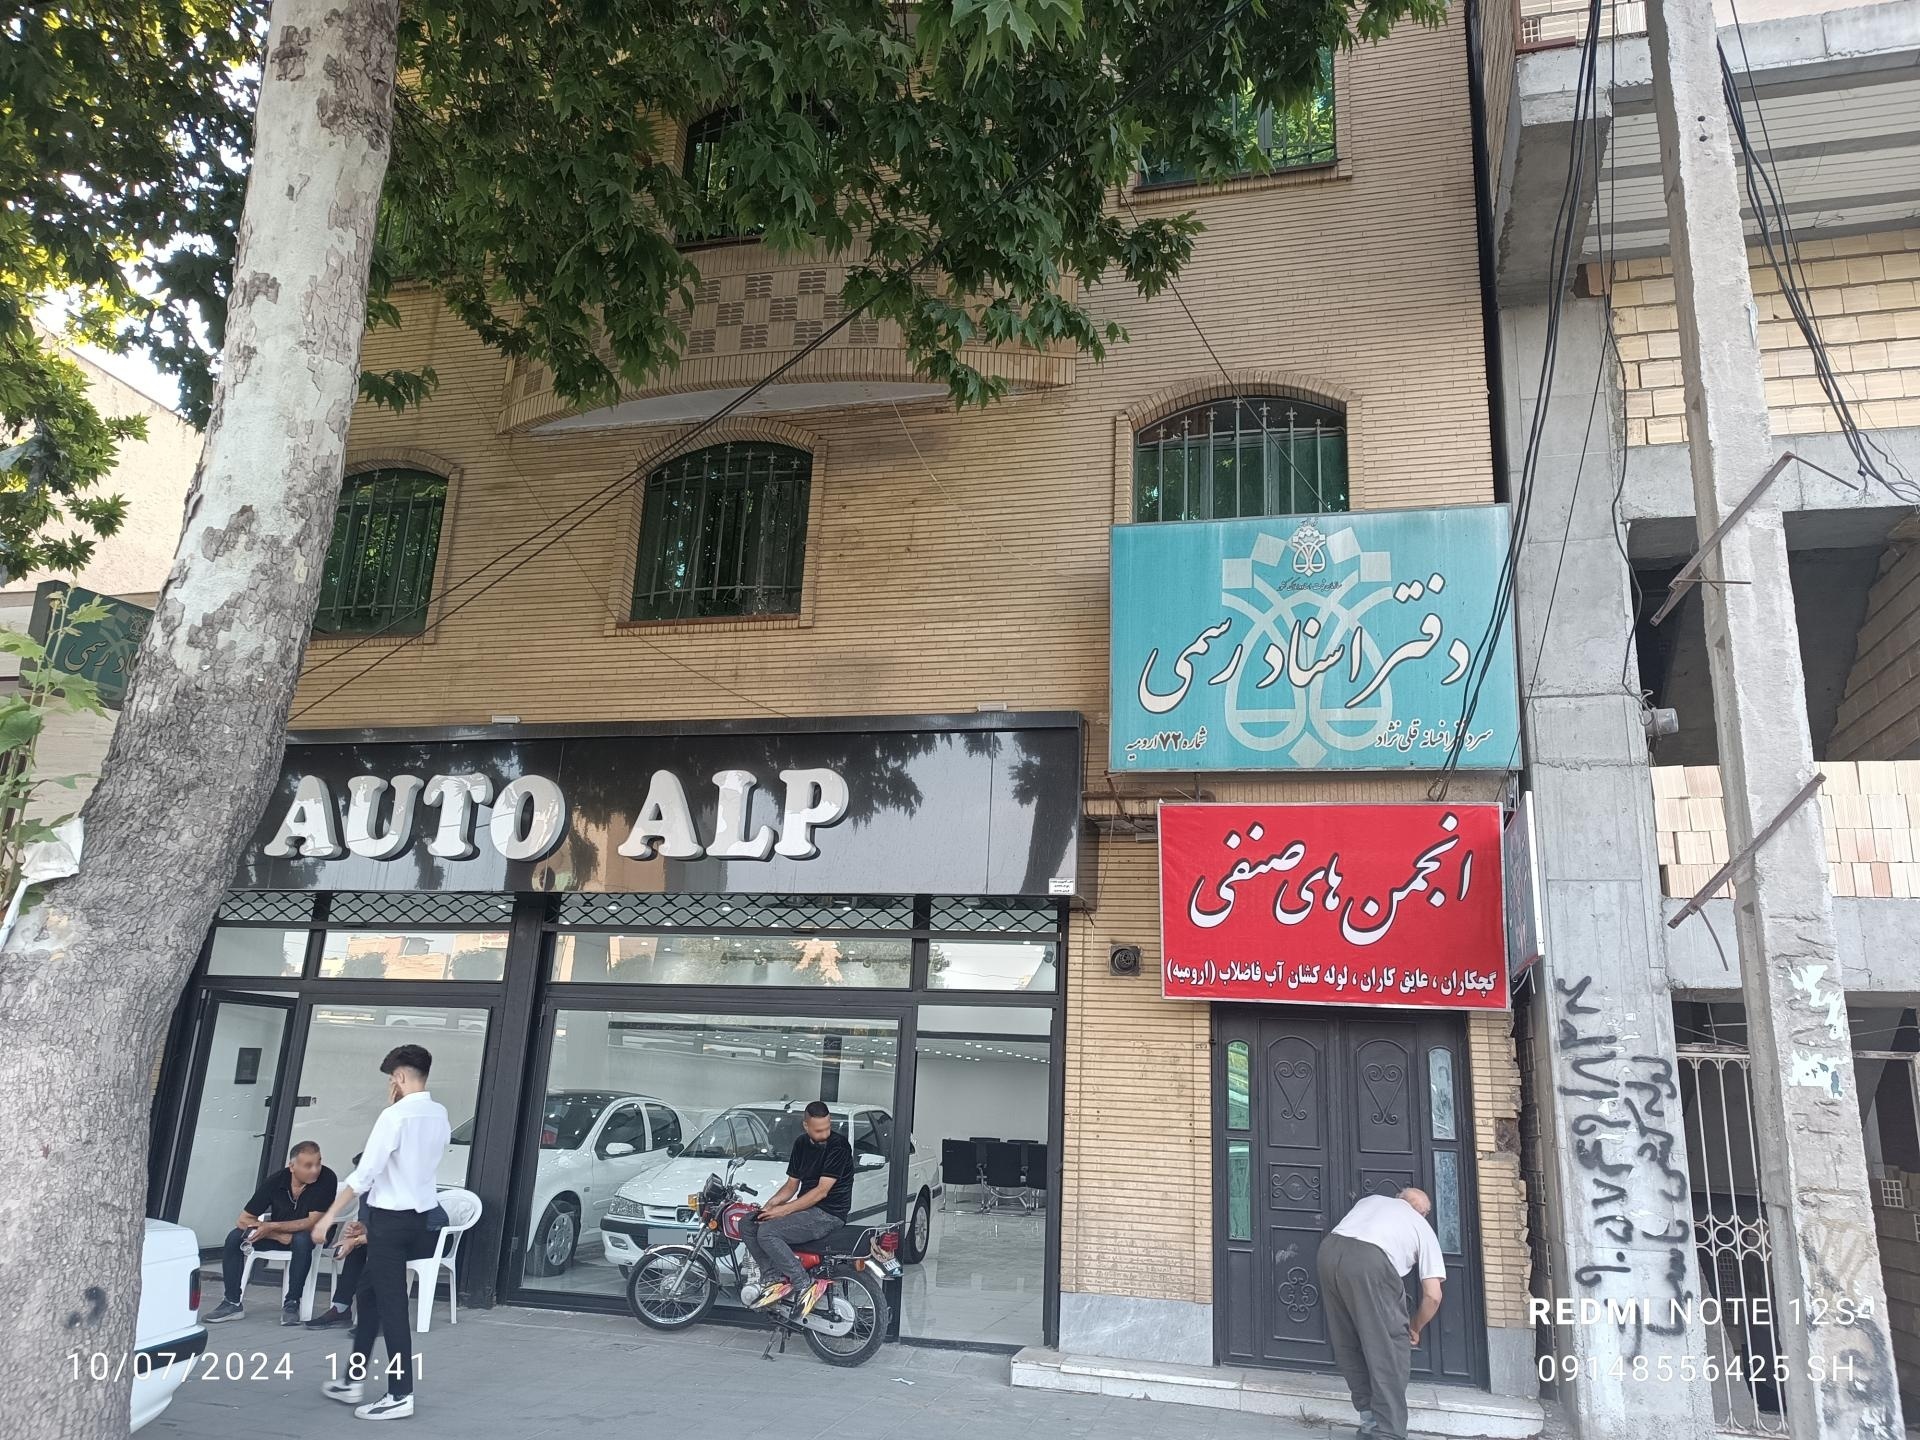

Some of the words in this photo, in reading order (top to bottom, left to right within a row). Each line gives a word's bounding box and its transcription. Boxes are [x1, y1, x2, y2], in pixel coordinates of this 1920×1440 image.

[1256, 617, 1362, 689] اسناد
[1345, 572, 1471, 709] دفتر
[1138, 617, 1243, 714] رسمی
[1125, 735, 1159, 761] ارومیه
[1158, 731, 1182, 751] ۷۲
[1181, 725, 1207, 750] شماره
[1420, 721, 1448, 748] افسانه
[264, 774, 568, 863] AUTO
[617, 768, 851, 861] ALP
[1188, 821, 1306, 928] صنفی
[1340, 811, 1473, 946] انجمن
[1274, 853, 1344, 925] های
[1166, 958, 1216, 985] (ارومیه)
[1218, 960, 1262, 985] فاضلاب
[1264, 960, 1286, 987] آب
[1287, 963, 1321, 989] کشان
[1323, 964, 1348, 991] لوله
[1400, 967, 1429, 993] عایق
